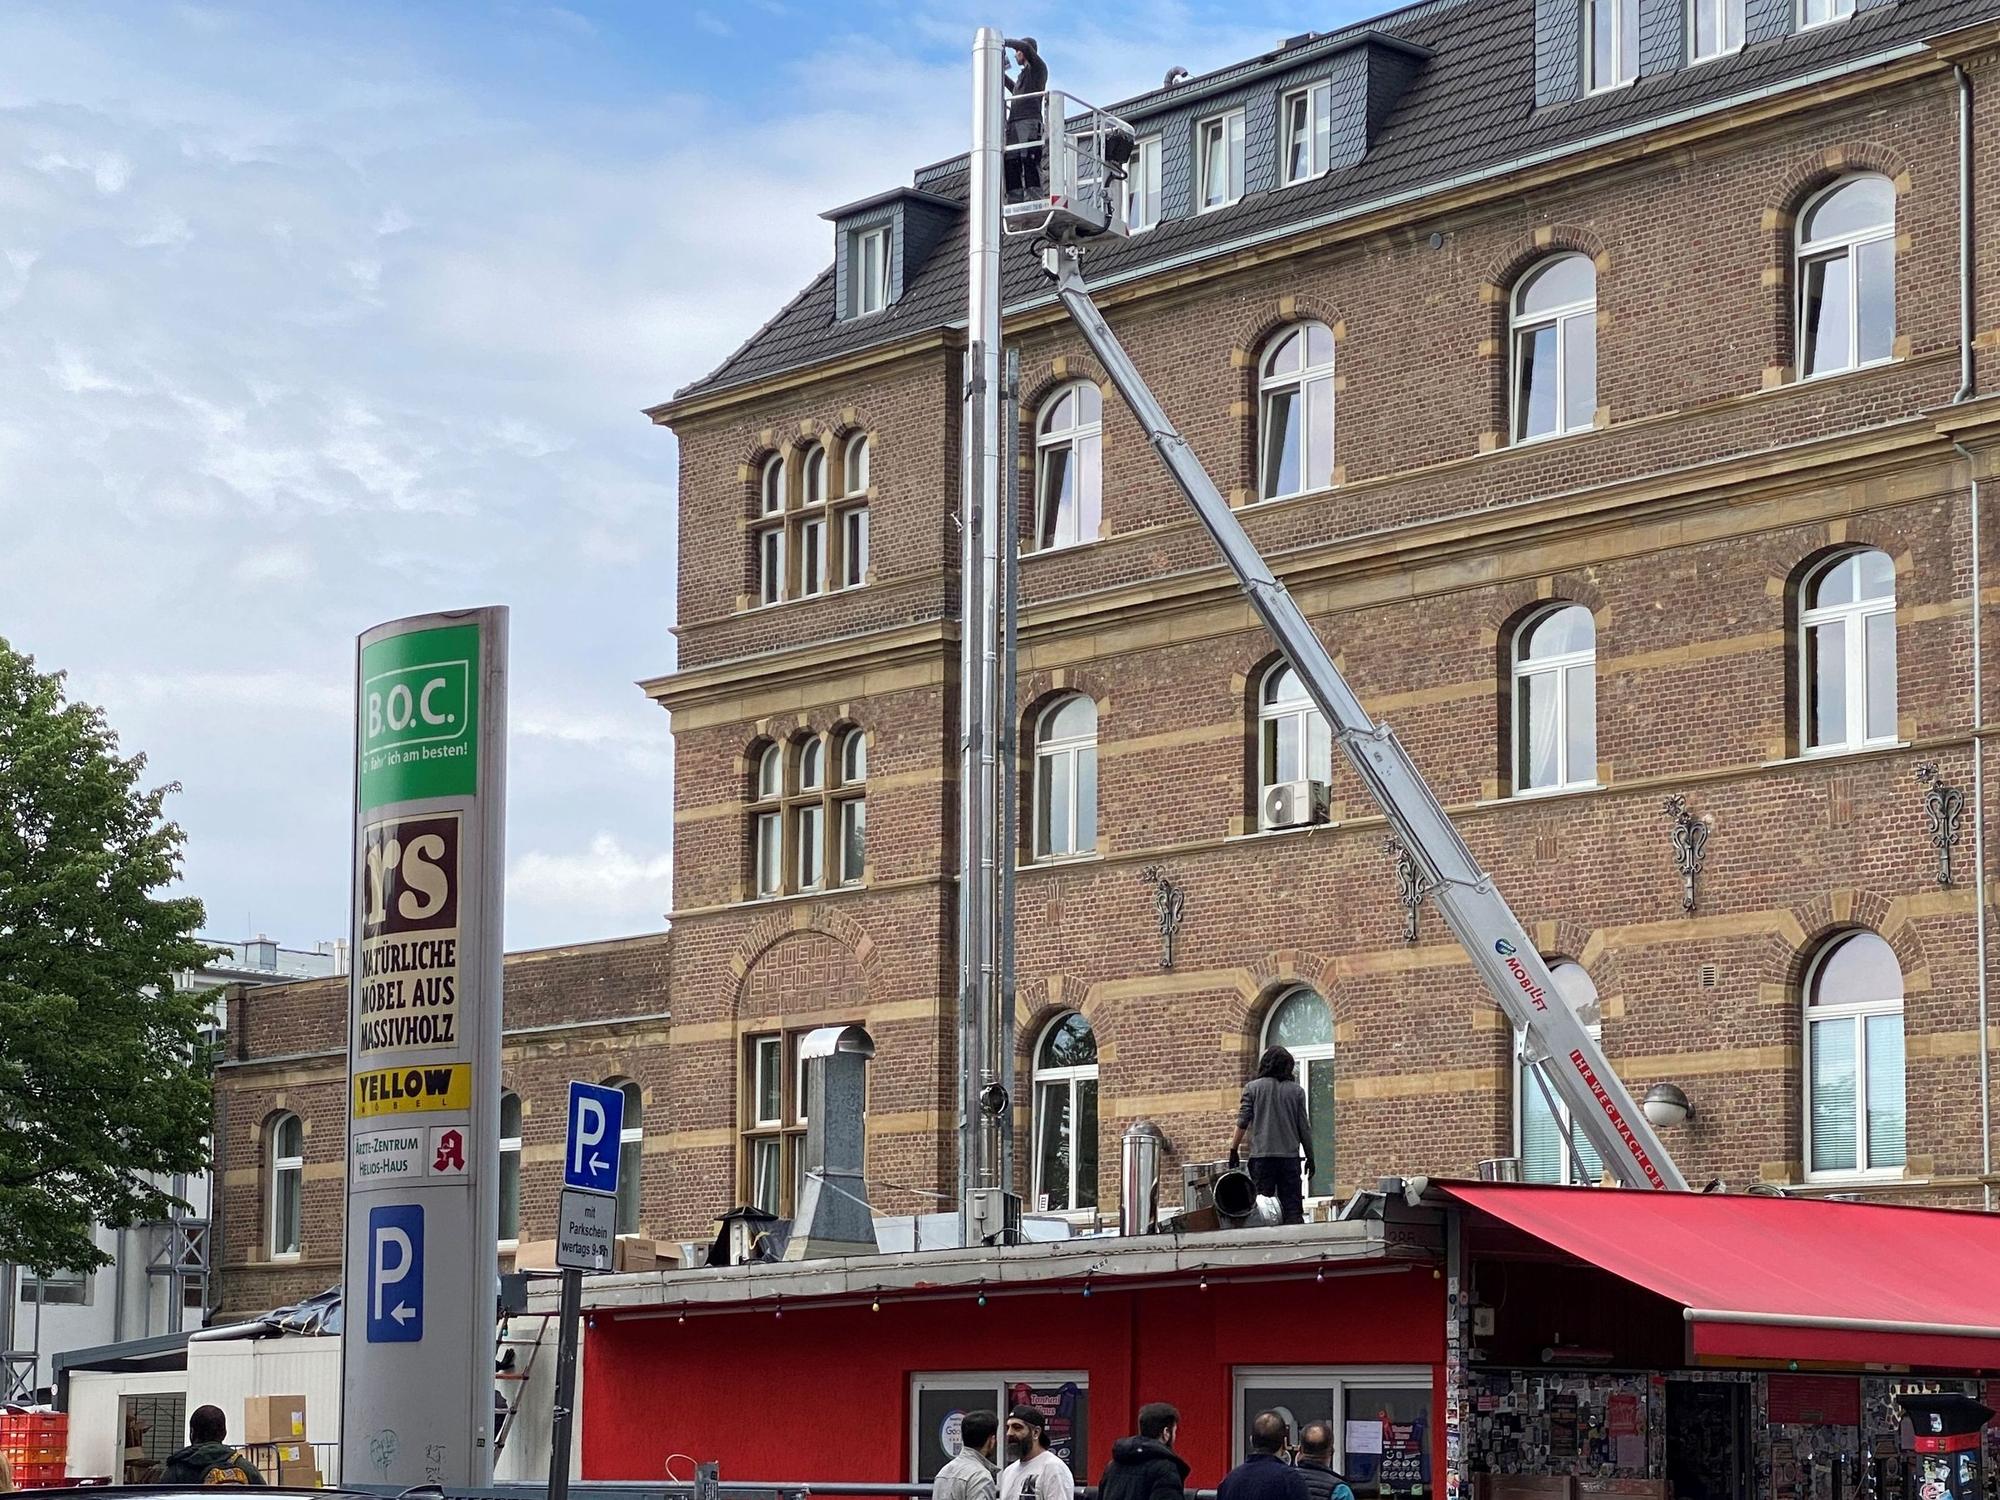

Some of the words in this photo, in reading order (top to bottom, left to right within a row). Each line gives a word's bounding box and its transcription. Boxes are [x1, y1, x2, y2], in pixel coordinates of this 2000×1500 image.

[387, 750, 401, 766] ich
[403, 750, 420, 763] am
[422, 741, 468, 760] besten!
[362, 939, 456, 979] NATÜRLICHE
[361, 979, 406, 1015] MÖBEL
[412, 976, 455, 1008] AUS
[361, 1013, 454, 1051] MASSIVHOLZ
[360, 1069, 453, 1103] YELLOW
[1571, 1051, 1592, 1079] IHR
[1591, 1081, 1616, 1114] WEG
[1614, 1117, 1646, 1161] NACH
[574, 1096, 606, 1173] P
[569, 1221, 608, 1239] Parkschein
[584, 1206, 596, 1219] mit
[561, 1241, 591, 1258] wertags
[374, 1226, 413, 1320] P
